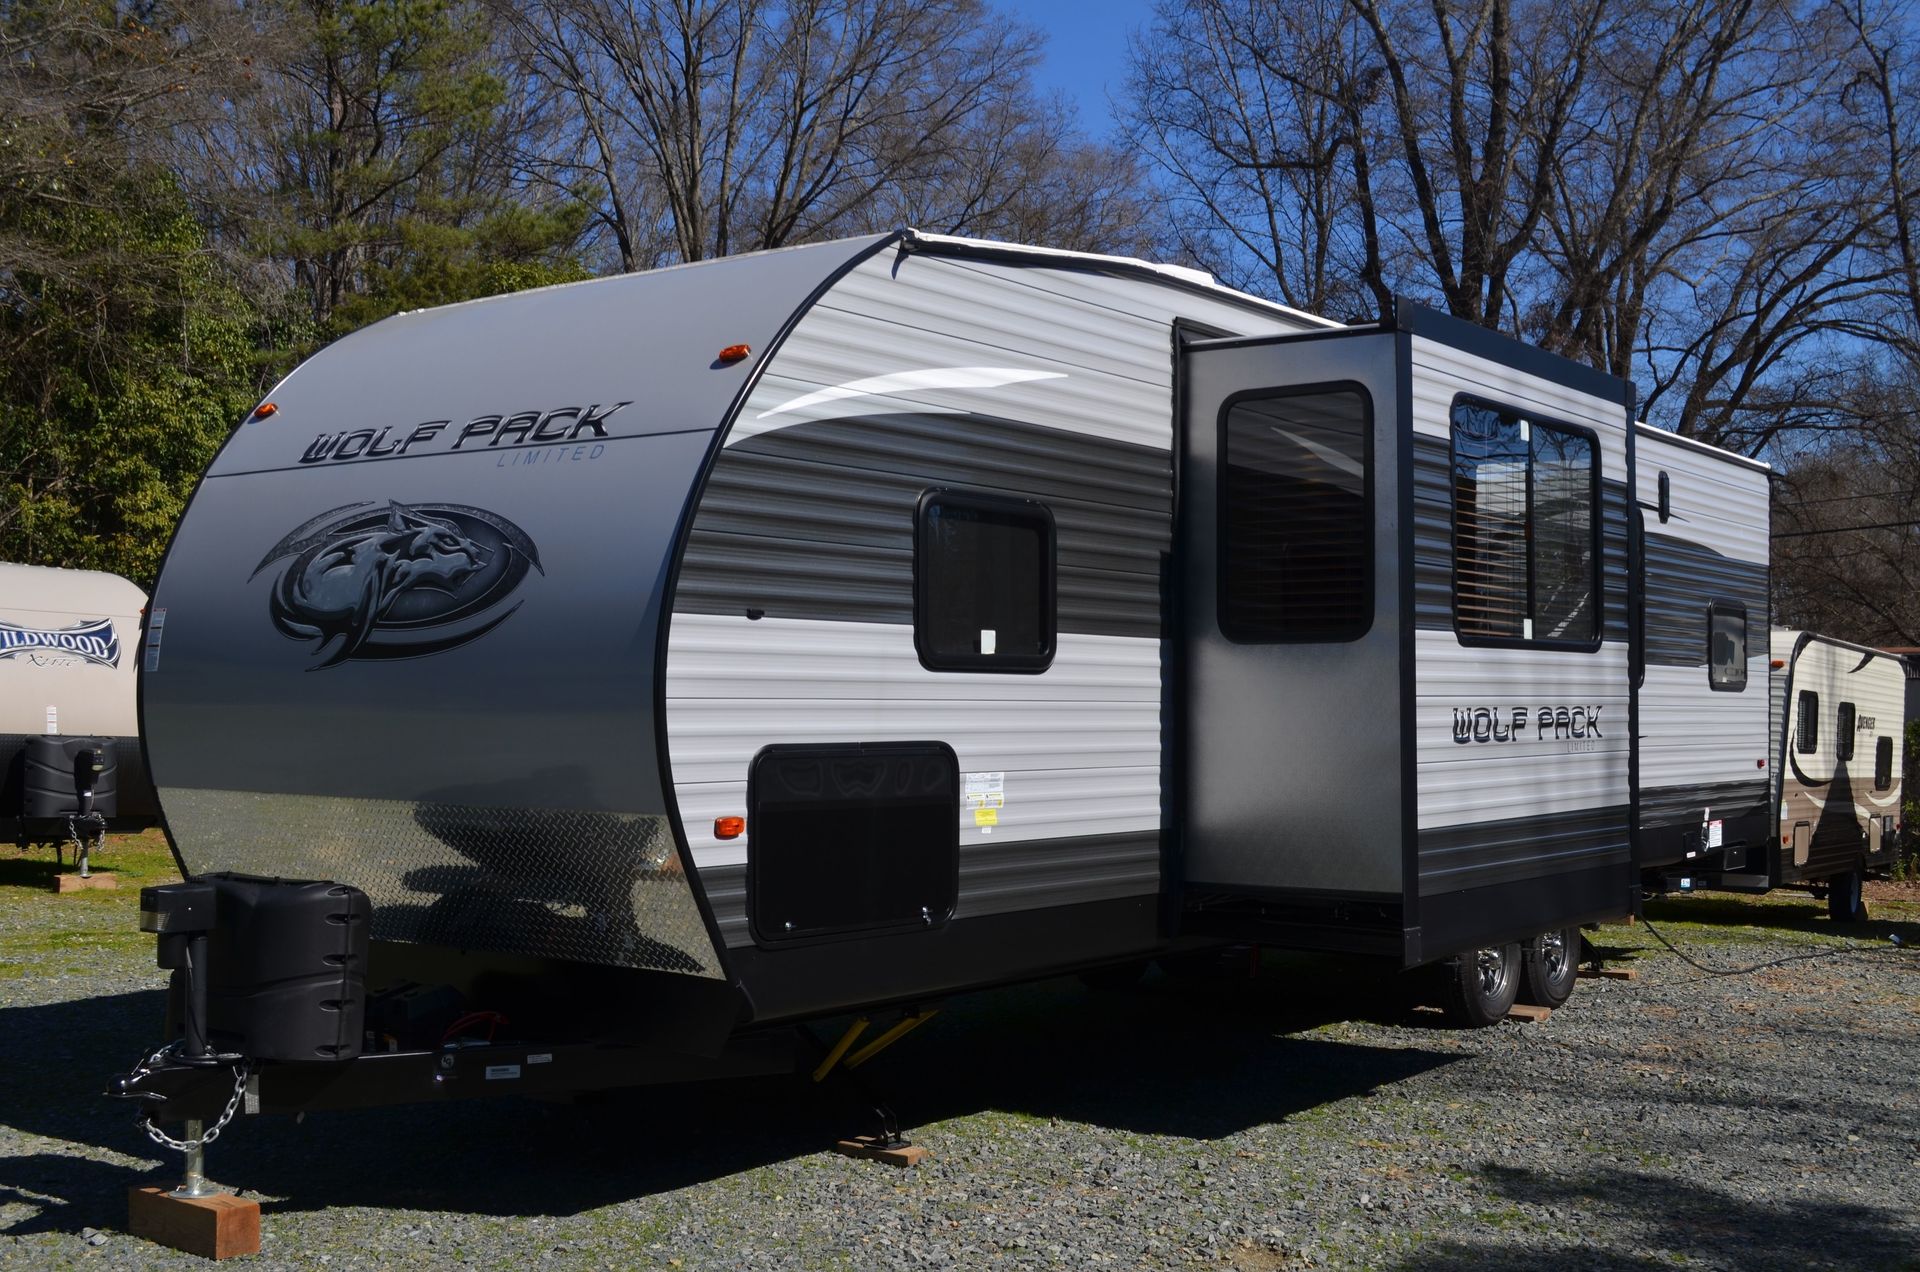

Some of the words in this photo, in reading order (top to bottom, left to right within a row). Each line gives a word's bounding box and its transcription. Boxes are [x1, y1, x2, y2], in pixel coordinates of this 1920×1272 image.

[298, 418, 452, 464] WOLF
[450, 400, 635, 450] PACK
[496, 444, 605, 468] LIMITED
[0, 630, 109, 659] ILDWOOD
[1452, 706, 1529, 745] WOLF
[1537, 705, 1603, 741] PACK
